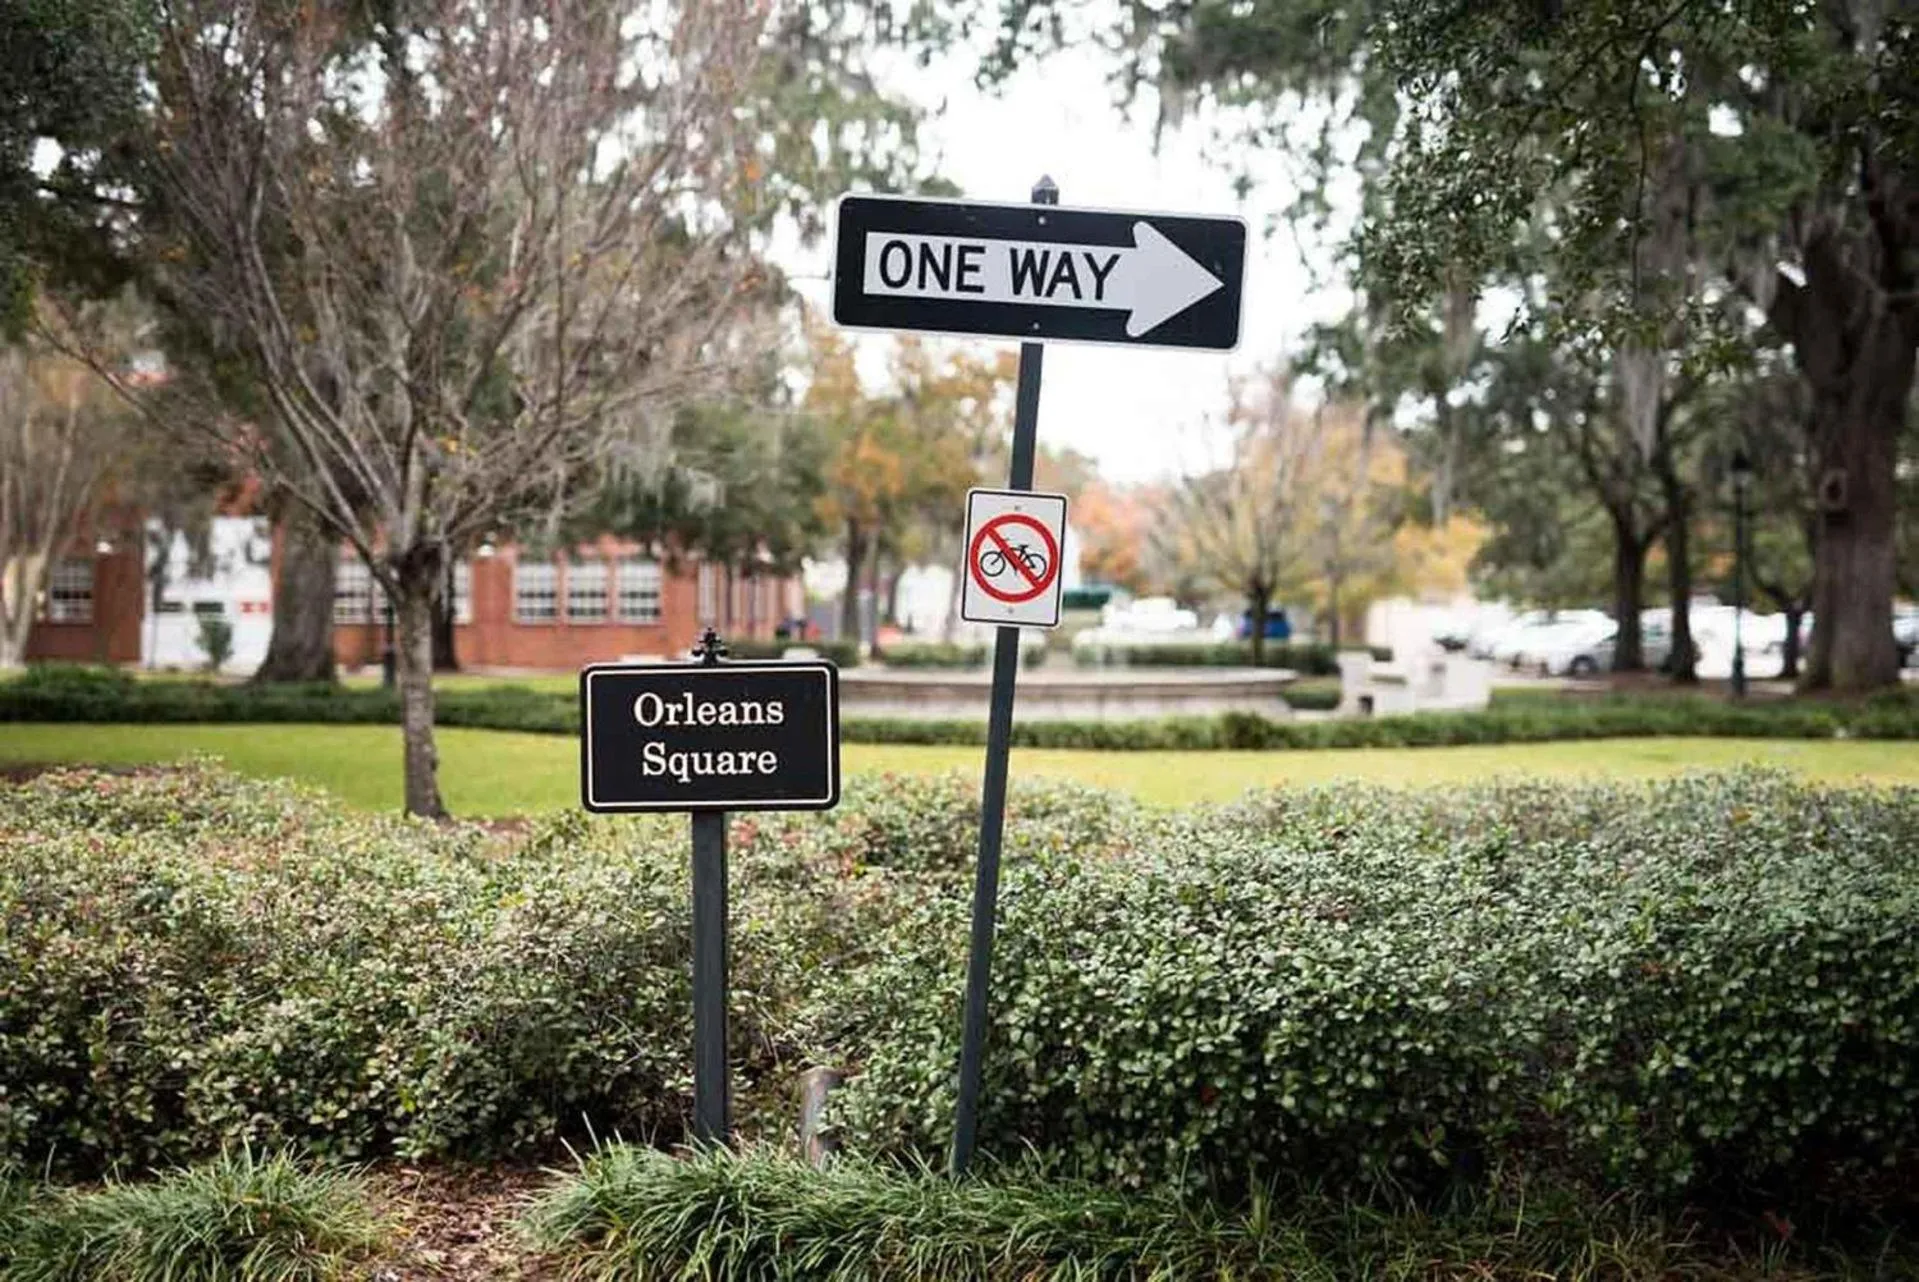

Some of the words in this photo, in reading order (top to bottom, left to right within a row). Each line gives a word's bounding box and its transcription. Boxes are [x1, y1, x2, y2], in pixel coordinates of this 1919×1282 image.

[879, 239, 986, 294] ONE
[1009, 247, 1121, 301] WAY
[633, 692, 785, 727] Orleans
[642, 741, 778, 783] Square
